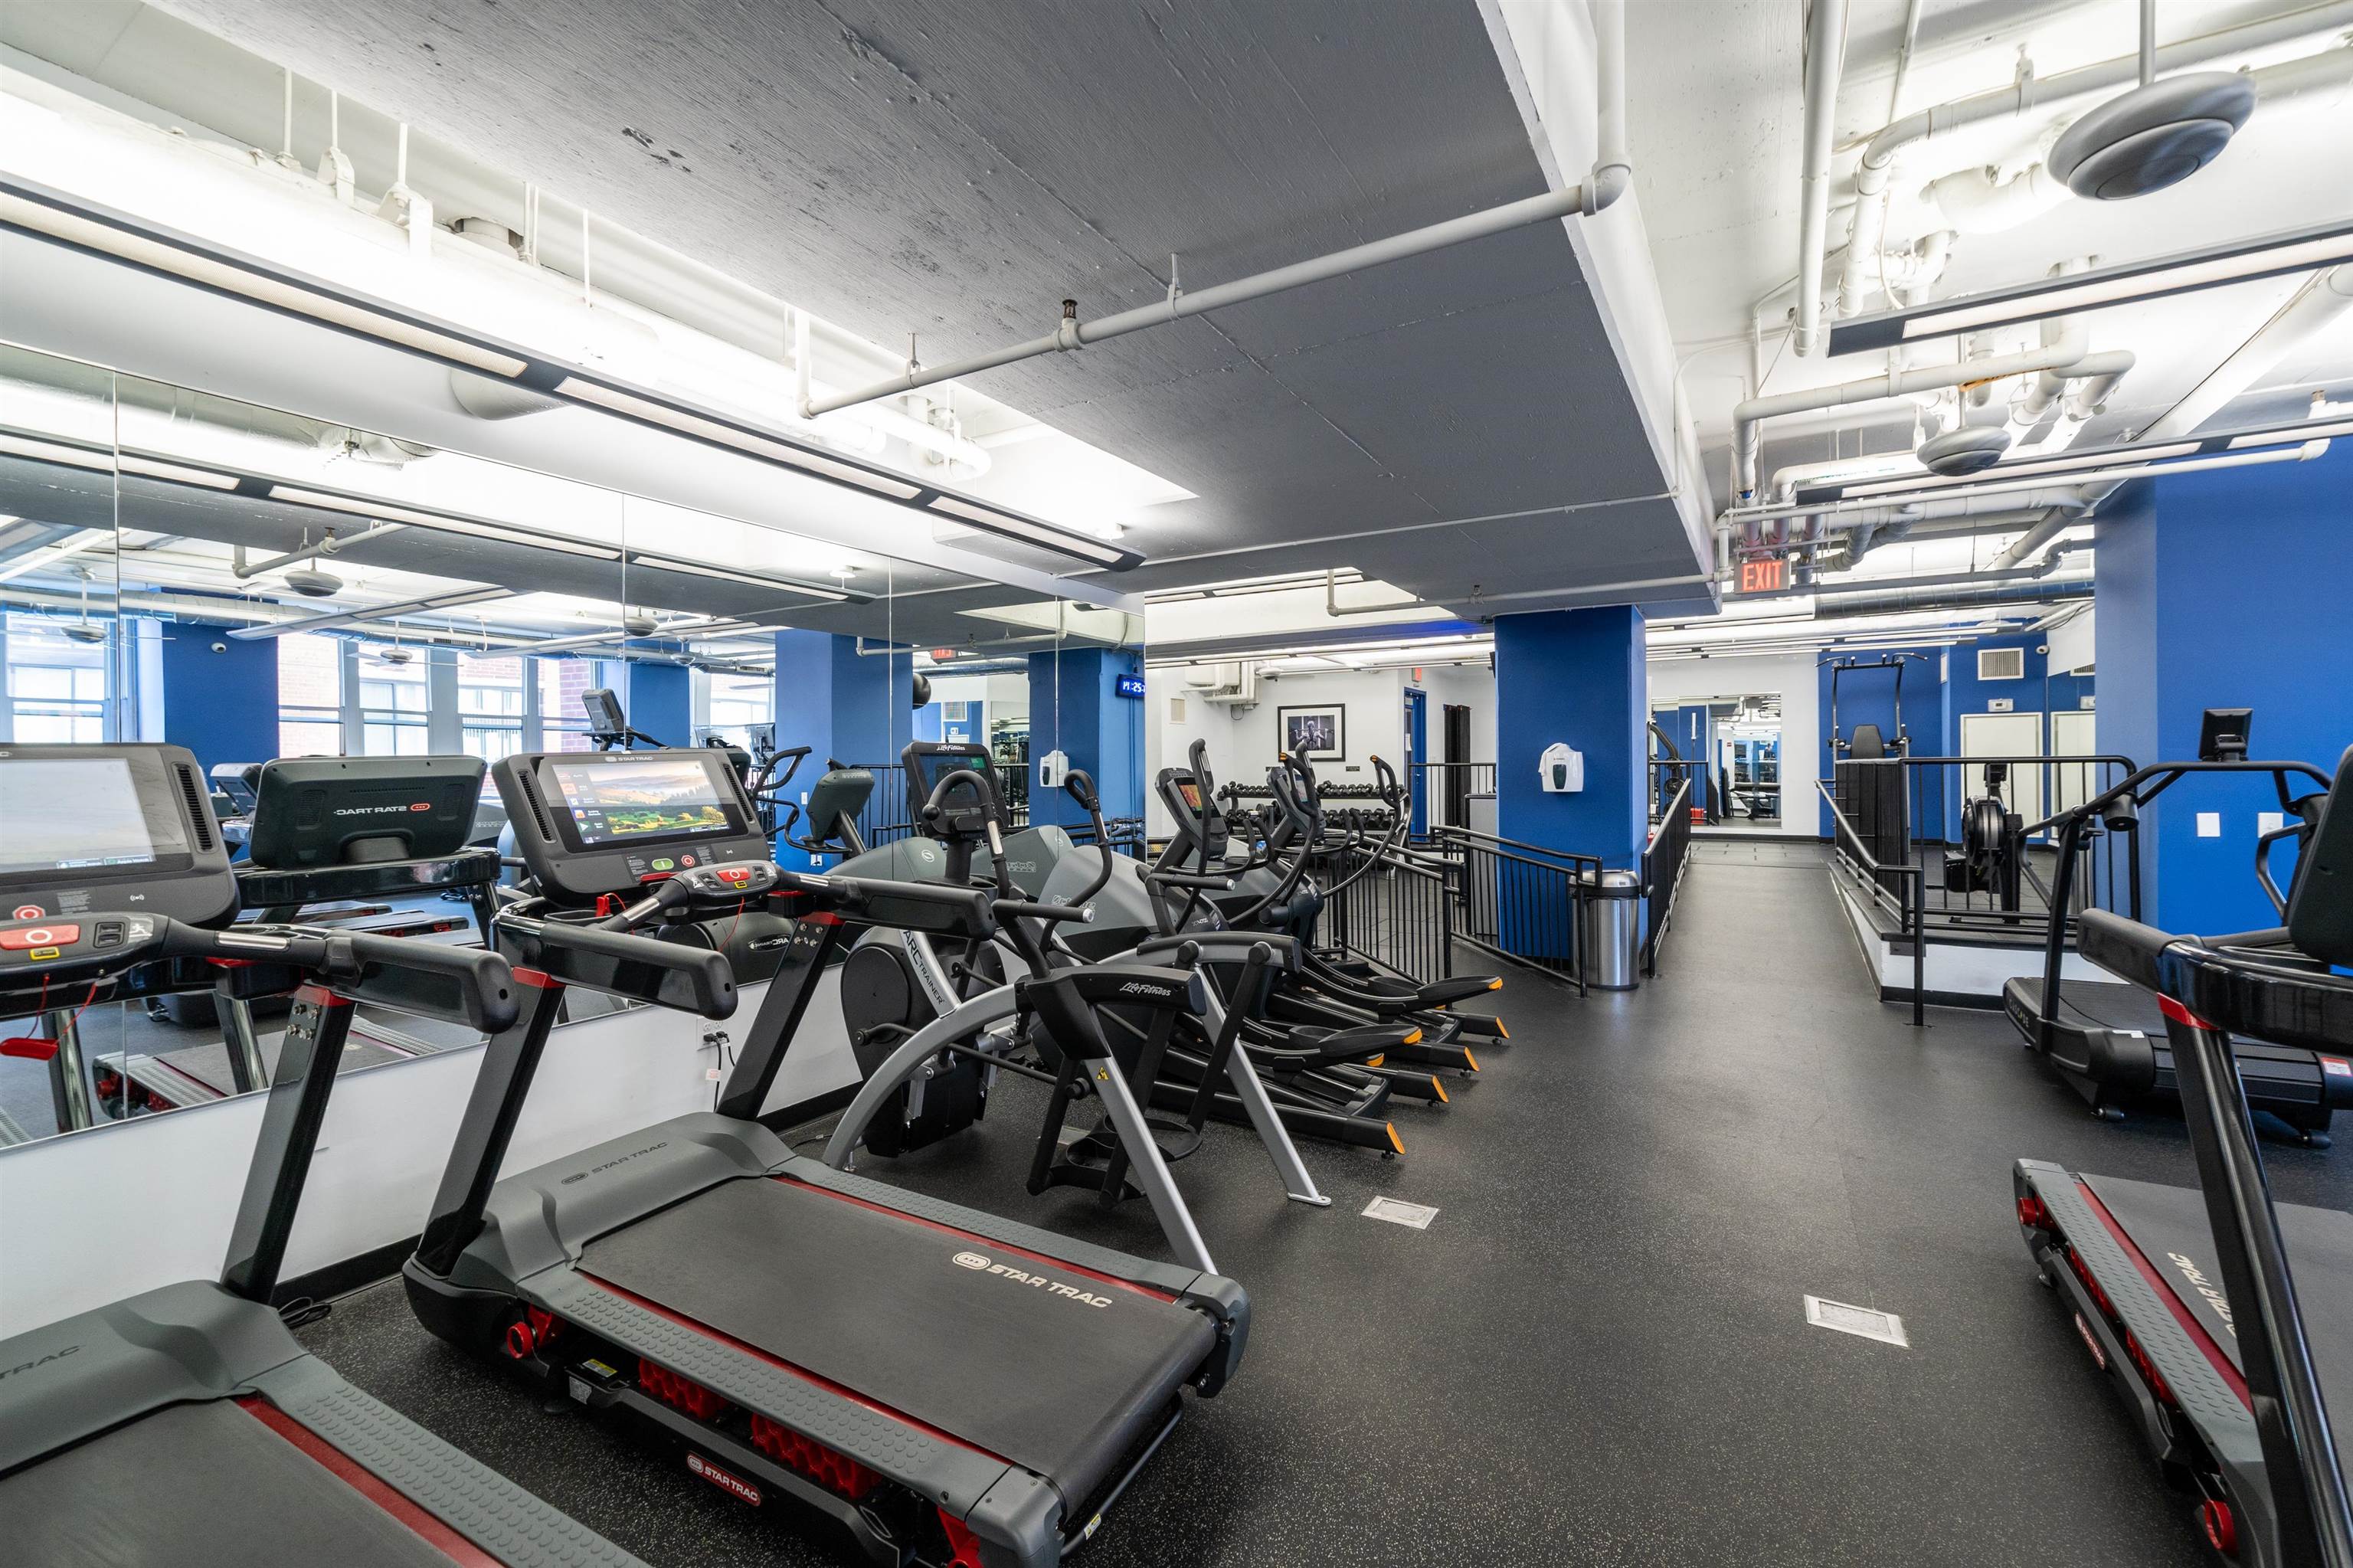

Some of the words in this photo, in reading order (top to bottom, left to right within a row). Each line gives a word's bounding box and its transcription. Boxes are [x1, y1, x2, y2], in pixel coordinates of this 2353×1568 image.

[1743, 561, 1783, 591] EXIT
[903, 929, 922, 965] ARC
[919, 961, 944, 1005] TRAINER
[592, 1157, 630, 1174] STAR
[630, 1141, 669, 1158] TRAC
[987, 1263, 1048, 1288] STAR
[1048, 1282, 1113, 1308] TRAC
[2167, 1252, 2212, 1286] TRAC
[705, 1466, 730, 1487] STAR
[730, 1480, 758, 1502] TRAC
